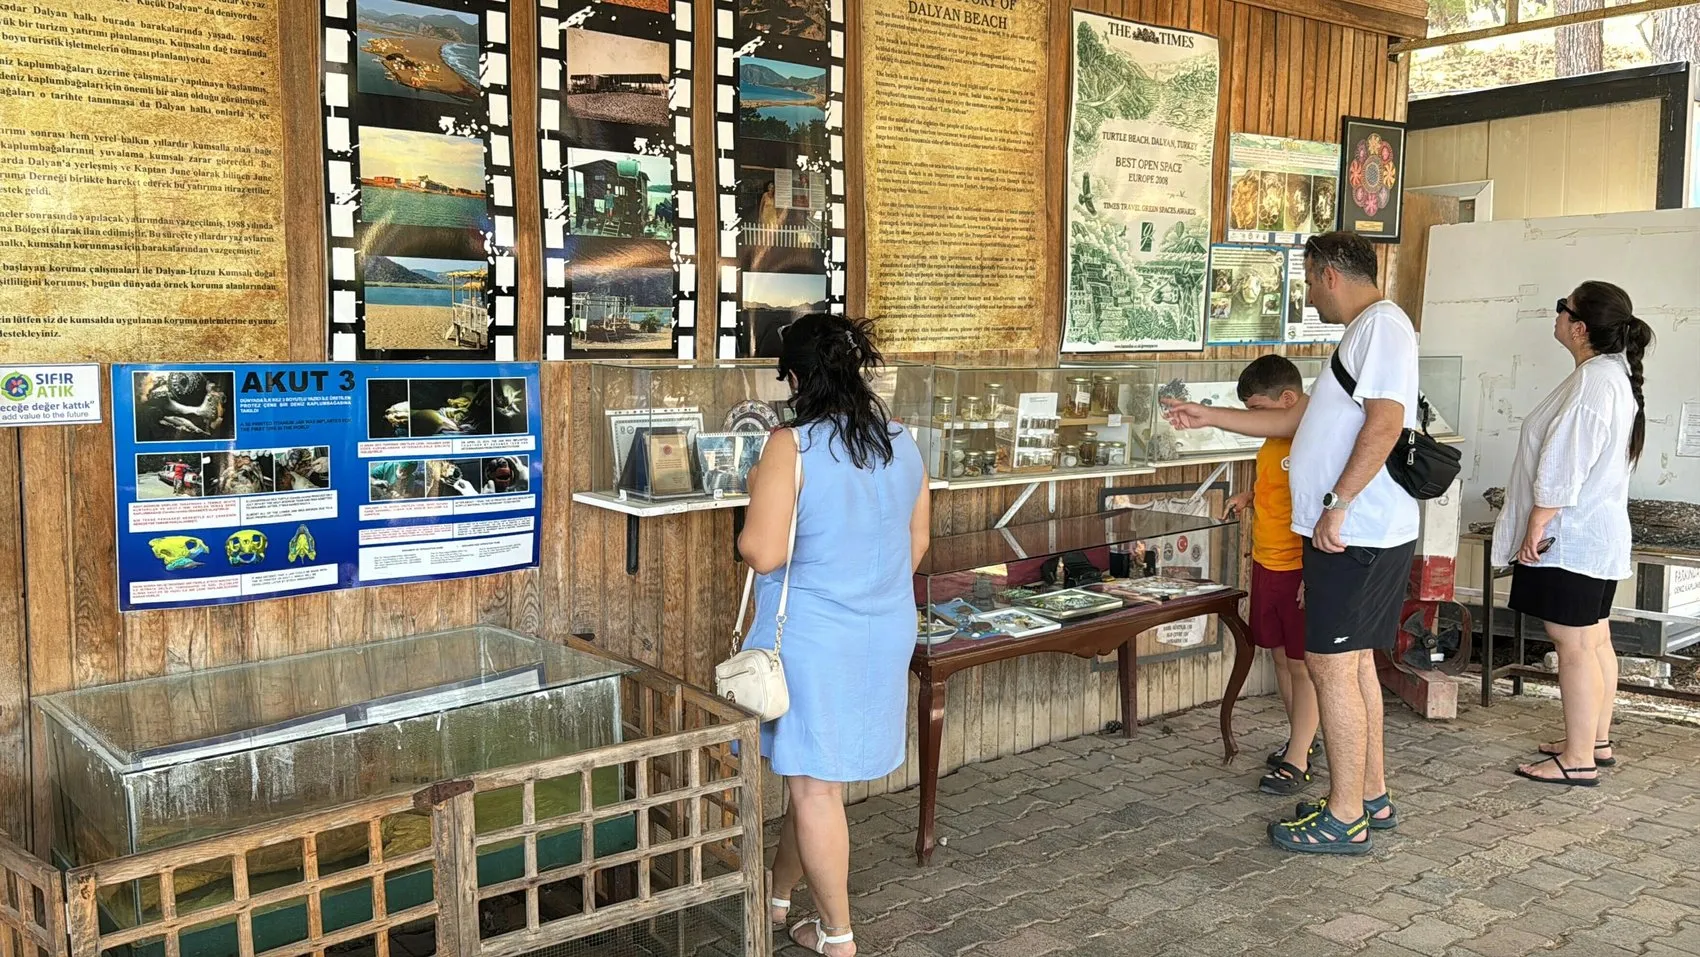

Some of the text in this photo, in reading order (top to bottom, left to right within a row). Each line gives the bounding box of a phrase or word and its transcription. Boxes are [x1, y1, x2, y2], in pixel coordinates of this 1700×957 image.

[204, 6, 214, 14] da
[908, 0, 960, 21] DALYAN
[964, 11, 1008, 29] BEACH
[33, 6, 68, 18] Dalyan
[74, 12, 97, 22] halkı
[102, 16, 136, 27] burada
[141, 20, 202, 36] barakalarında
[18, 20, 33, 28] bir
[36, 22, 68, 32] turizm
[70, 27, 108, 38] yatırımı
[110, 32, 168, 46] planlanmıştı.
[170, 39, 211, 51] Kumsalın
[212, 45, 228, 54] dağ
[230, 48, 267, 58] tarafında
[1108, 22, 1194, 48] THE TIMES
[2, 32, 214, 64] boyu turistik işletmelerin olması planlanıyordu.
[17, 58, 94, 74] kaplumbağaları
[96, 69, 130, 78] üzerine
[132, 72, 178, 83] çalışmalar
[180, 77, 224, 89] yapılmaya
[28, 74, 104, 89] kaplumbağaları
[104, 82, 122, 92] için
[124, 84, 154, 94] önemli
[156, 86, 168, 96] bir
[170, 90, 188, 98] alan
[190, 92, 219, 102] olduğu
[51, 92, 84, 102] tarihte
[88, 95, 135, 106] tanınmasa
[140, 100, 150, 108] da
[156, 101, 186, 112] Dalyan
[190, 104, 212, 114] halkı
[216, 108, 245, 118] onlarla
[30, 130, 65, 138] sonrası
[70, 132, 90, 140] hem
[94, 134, 117, 144] yerel
[120, 136, 150, 145] halkın
[154, 138, 189, 148] yıllardır
[192, 141, 230, 152] kumsalla
[1102, 132, 1127, 142] TURTLE
[1151, 137, 1176, 149] DALYAN,
[1177, 140, 1198, 150] TURKEY
[0, 141, 94, 154] kaplumbağalarının
[100, 149, 144, 159] yuvalama
[150, 151, 184, 162] kumsalı
[188, 156, 212, 164] zarar
[28, 156, 71, 168] Dalyan'a
[74, 161, 118, 172] yerleşmiş
[134, 164, 167, 174] Kaptan
[170, 167, 191, 176] June
[193, 169, 220, 178] olarak
[1116, 156, 1183, 173] BEST OPEN SPACE
[29, 172, 68, 183] Derneği
[70, 174, 104, 184] birlikte
[106, 177, 140, 186] hareket
[174, 180, 185, 189] bu
[187, 182, 222, 192] yatırıma
[1128, 173, 1169, 185] EUROPE 2008
[26, 211, 78, 220] sonrasında
[227, 220, 246, 228] 1988
[15, 224, 50, 234] Bölgesi
[51, 226, 82, 235] olarak
[83, 227, 101, 236] ilan
[102, 228, 148, 238] edilmiştir.
[148, 230, 161, 238] Bu
[162, 230, 193, 240] süreçte
[28, 240, 72, 250] kumsalın
[73, 241, 123, 251] korunması
[124, 242, 141, 252] için
[142, 244, 208, 254] barakalarından
[2, 263, 276, 279] başlayan koruma çalışmaları ile Dalyan-İztuzu Kumsalı doğal
[44, 278, 90, 288] korumuş,
[92, 280, 121, 289] bugün
[123, 280, 161, 290] dünyada
[164, 280, 188, 289] örnek
[190, 282, 224, 290] koruma
[226, 282, 276, 290] alanlarından
[13, 315, 41, 324] lütfen
[43, 315, 56, 324] siz
[57, 316, 68, 324] de
[70, 316, 114, 324] kumsalda
[116, 316, 162, 326] uygulanan
[164, 316, 198, 326] koruma
[36, 373, 73, 384] SIFIR
[241, 370, 356, 393] AKUT 3
[37, 385, 74, 398] ATIK
[32, 402, 60, 412] değer
